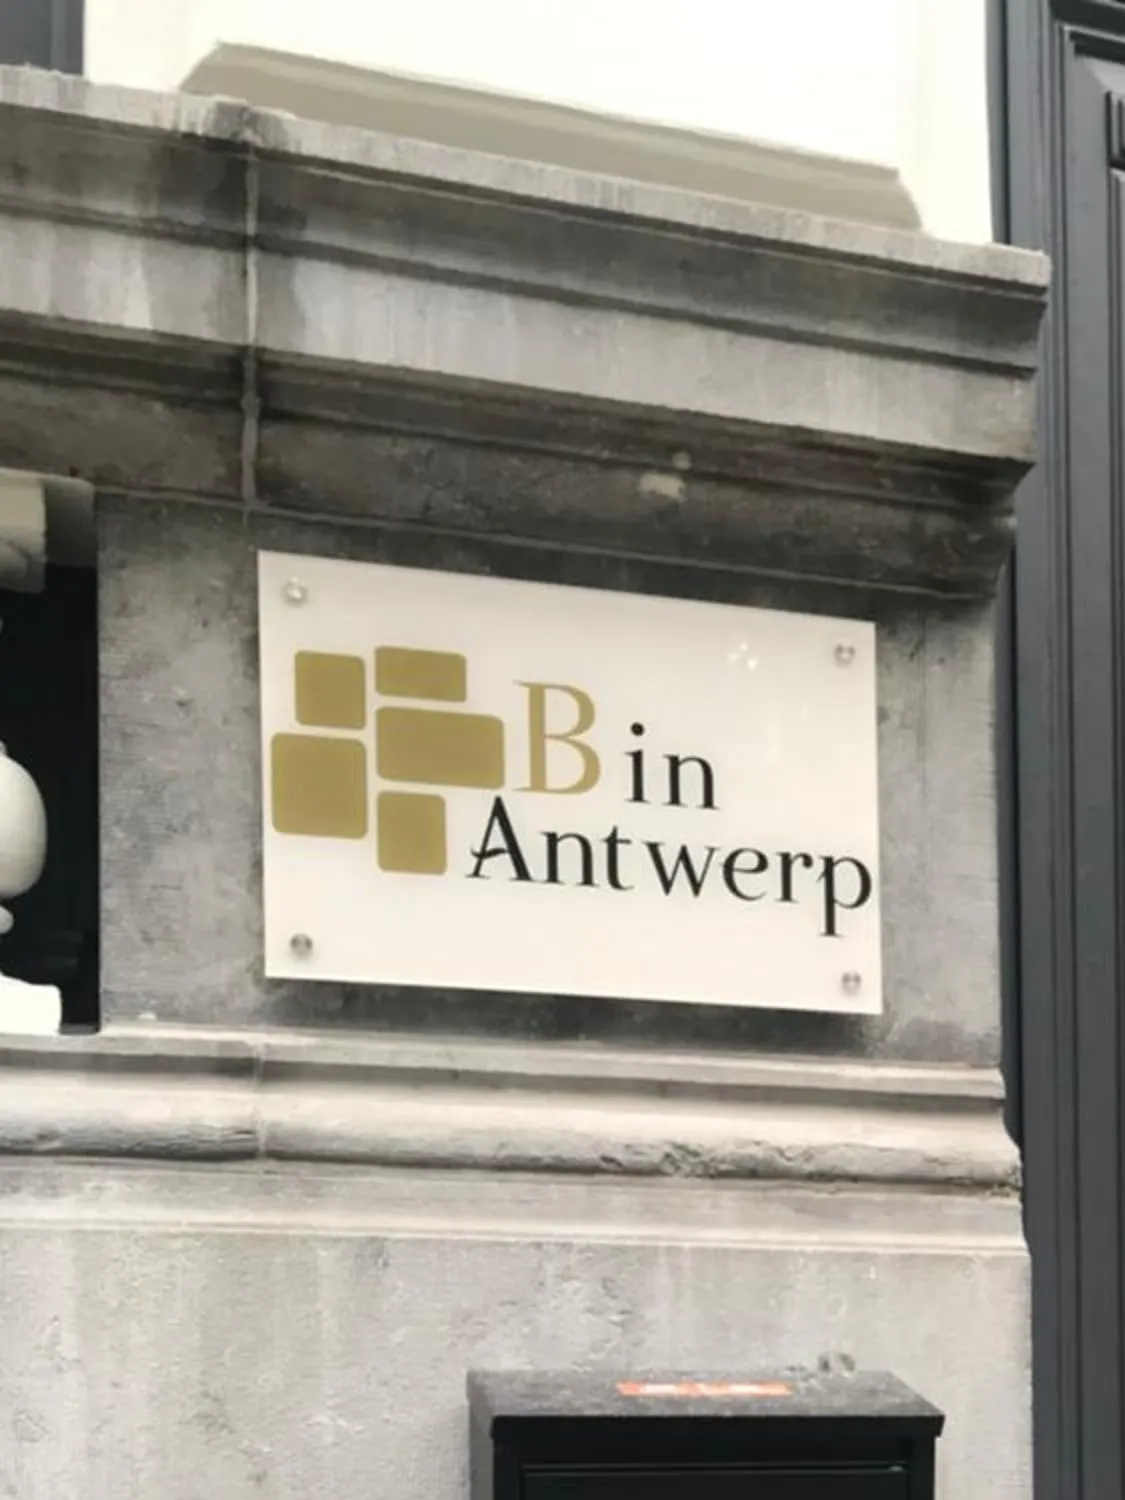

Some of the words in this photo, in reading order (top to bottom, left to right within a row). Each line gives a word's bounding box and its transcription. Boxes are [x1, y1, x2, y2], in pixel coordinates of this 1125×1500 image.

[513, 680, 601, 795] B
[624, 722, 720, 810] in
[466, 795, 873, 937] Antwerp
